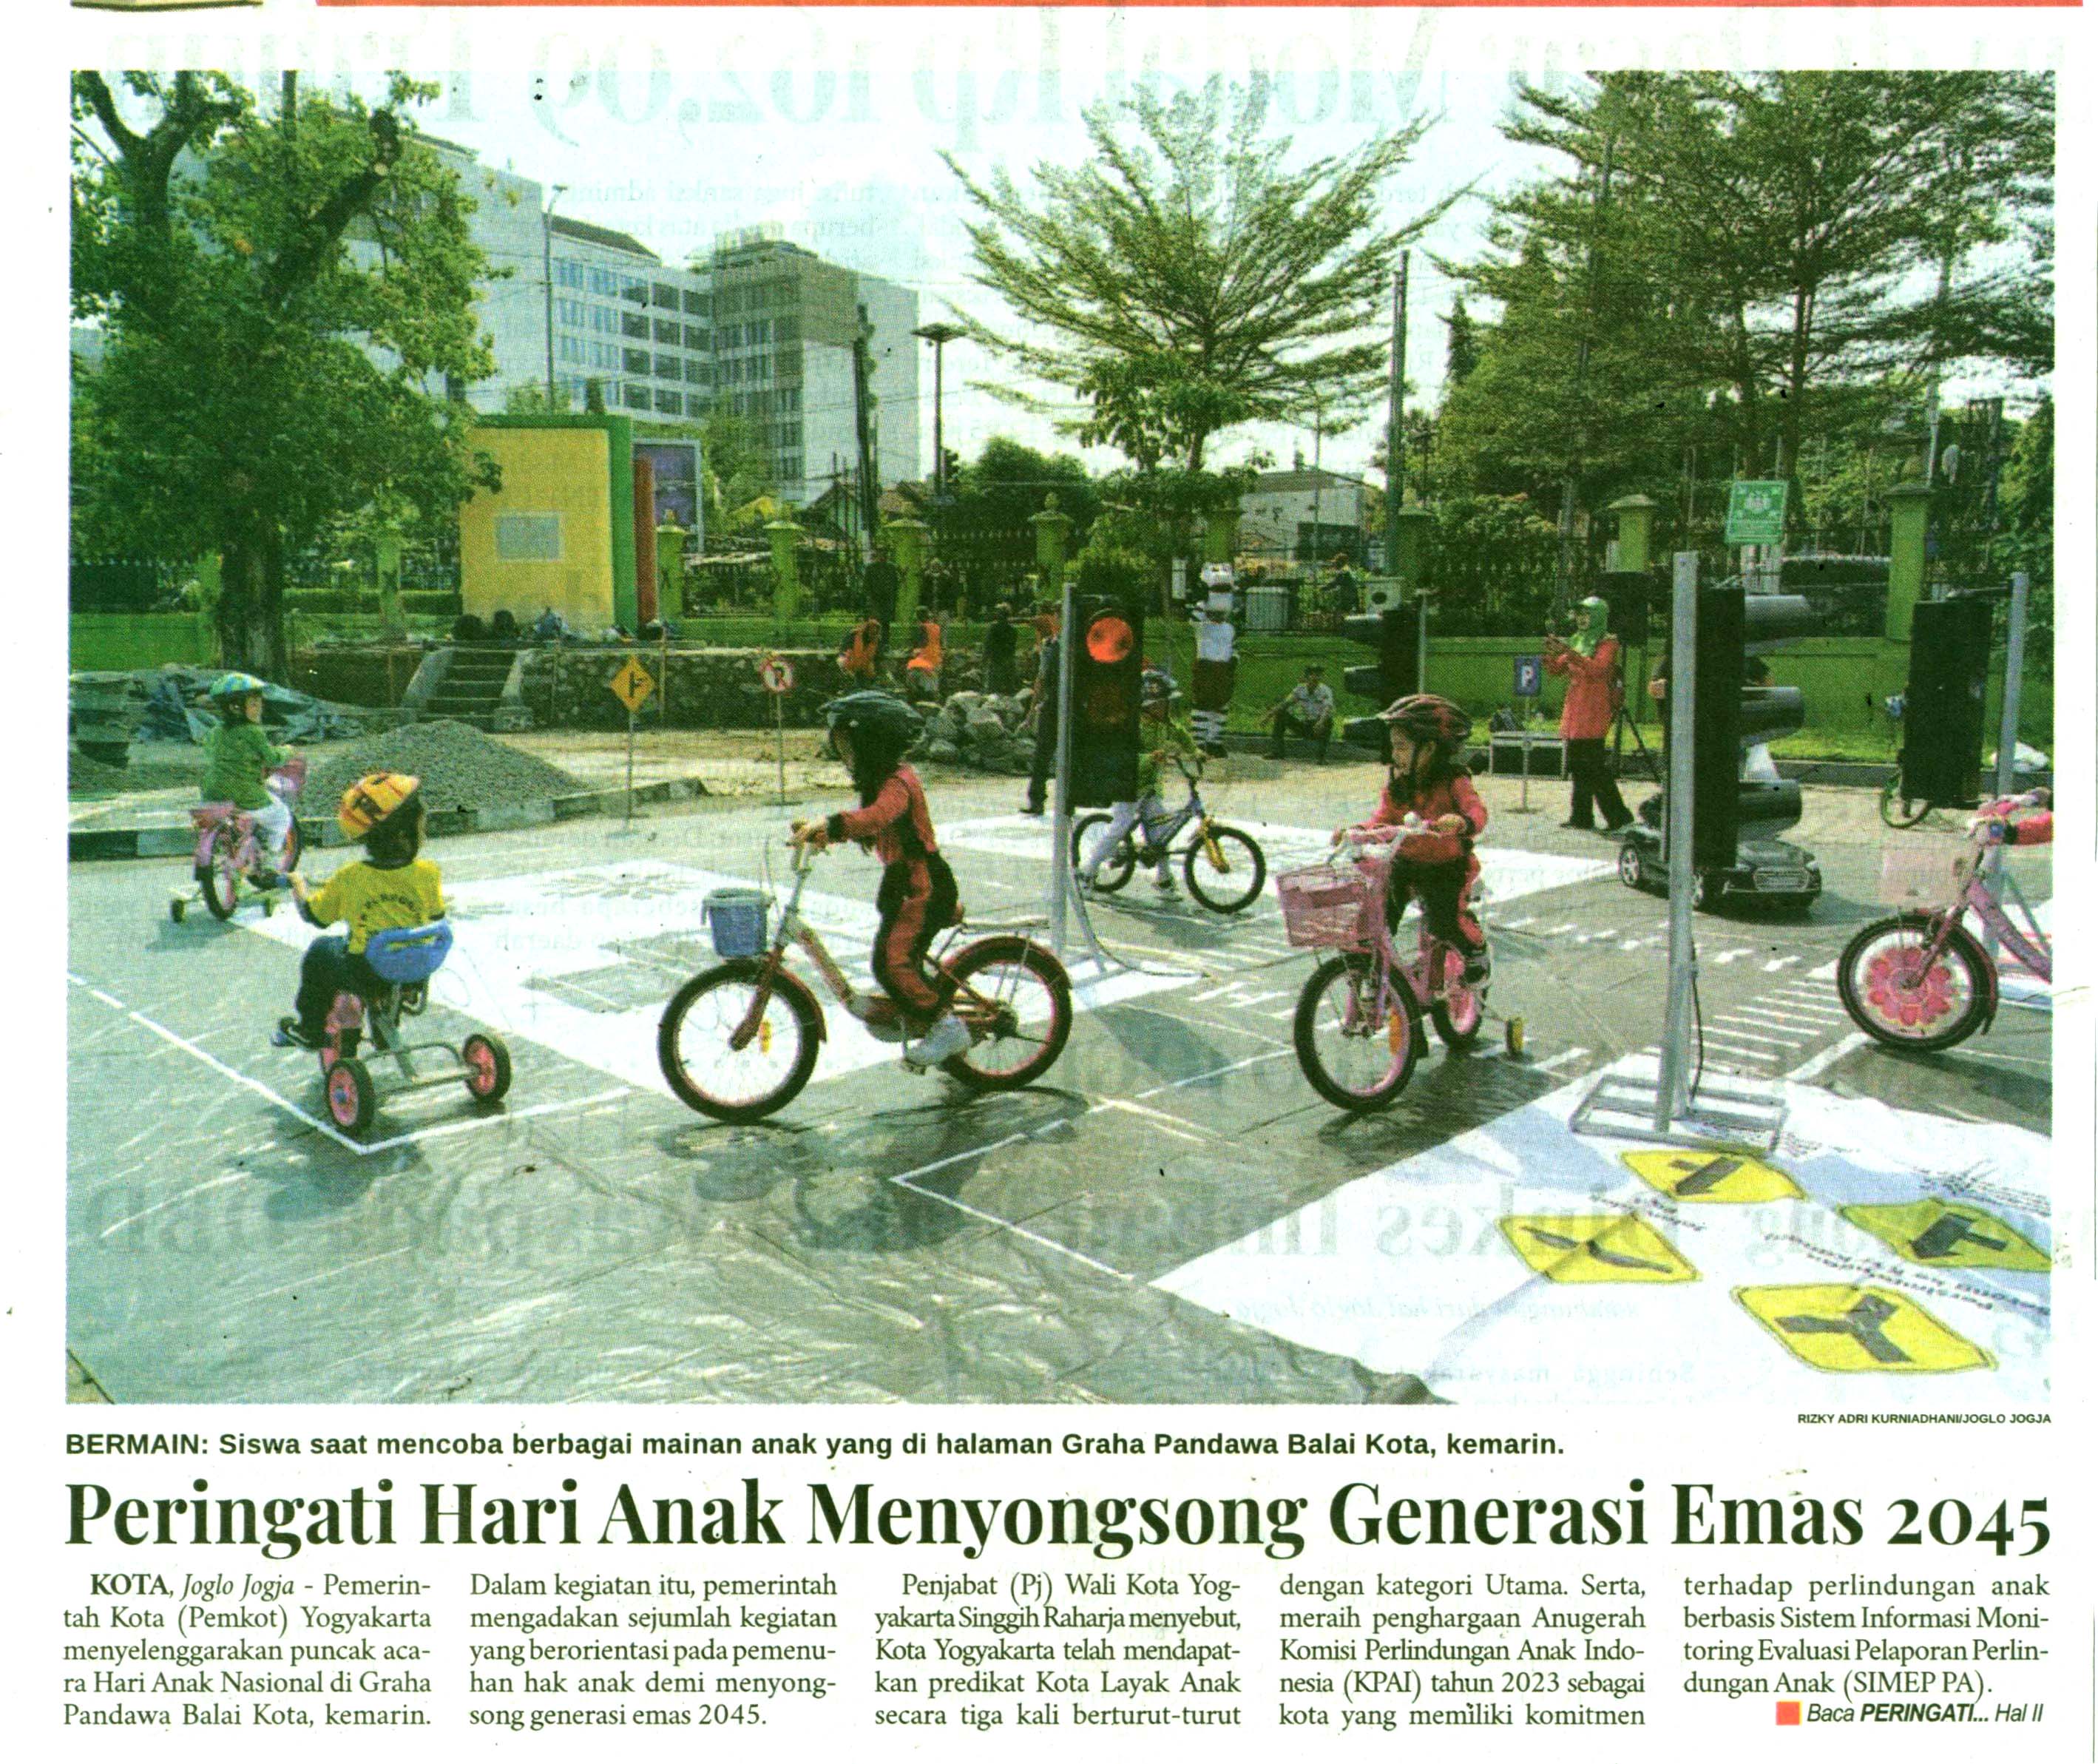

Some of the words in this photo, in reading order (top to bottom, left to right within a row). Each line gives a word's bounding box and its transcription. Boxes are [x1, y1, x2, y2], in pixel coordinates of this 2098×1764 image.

[1520, 665, 1534, 687] P
[1798, 1413, 1835, 1424] RIZKY
[1838, 1413, 1868, 1424] ADRI
[1871, 1413, 2006, 1424] KURNIADHANI/JOGLO
[2009, 1413, 2051, 1424] JOGJA
[66, 1433, 208, 1455] BERMAIN:
[219, 1433, 301, 1455] Siswa
[310, 1435, 368, 1455] saat
[377, 1433, 504, 1455] mencoba
[512, 1432, 632, 1460] berbagai
[643, 1432, 742, 1455] mainan
[751, 1432, 817, 1454] anak
[825, 1437, 892, 1460] yang
[901, 1432, 926, 1455] di
[937, 1432, 1052, 1455] halaman
[1062, 1432, 1146, 1455] Graha
[1154, 1432, 1279, 1455] Pandawa
[1288, 1433, 1356, 1455] Balai
[1366, 1433, 1436, 1459] Kota,
[1447, 1433, 1564, 1455] kemarin.
[64, 1478, 397, 1560] Peringati
[419, 1478, 581, 1545] Hari
[597, 1477, 786, 1545] Anak
[806, 1483, 1308, 1560] Menyongsong
[1329, 1478, 1648, 1546] Generasi
[1671, 1484, 1864, 1546] Emas
[1887, 1496, 2051, 1557] 2045
[90, 1573, 174, 1597] KOTA,
[180, 1573, 234, 1602] Joglo
[240, 1573, 294, 1602] Jogja
[324, 1573, 430, 1595] Pemerin-
[471, 1572, 547, 1595] Dalam
[555, 1572, 652, 1602] kegiatan
[659, 1574, 695, 1598] itu,
[703, 1572, 838, 1602] pemerintah
[902, 1572, 998, 1601] Penjabat
[1010, 1572, 1053, 1606] (Pj)
[1065, 1572, 1116, 1595] Wali
[1126, 1572, 1180, 1595] Kota
[1188, 1573, 1240, 1602] Yog-
[1279, 1572, 1364, 1602] dengan
[1376, 1572, 1472, 1602] kategori
[1486, 1573, 1568, 1595] Utama.
[1581, 1573, 1645, 1598] Serta,
[1684, 1573, 1793, 1602] terhadap
[1809, 1573, 1975, 1602] perlindungan
[1992, 1573, 2050, 1596] anak
[63, 1605, 100, 1628] tah
[110, 1606, 165, 1628] Kota
[177, 1604, 288, 1638] (Pemkot)
[300, 1605, 431, 1635] Yogyakarta
[470, 1605, 619, 1635] mengadakan
[628, 1605, 731, 1634] sejumlah
[740, 1605, 837, 1635] kegiatan
[875, 1605, 955, 1634] yakarta
[958, 1605, 1040, 1635] Singgih
[1043, 1606, 1126, 1635] Raharja
[1128, 1605, 1241, 1635] menyebut,
[1280, 1605, 1361, 1628] meraih
[1373, 1605, 1521, 1635] penghargaan
[1532, 1605, 1646, 1635] Anugerah
[1683, 1605, 1776, 1629] berbasis
[1780, 1606, 1856, 1628] Sistem
[1861, 1605, 1971, 1629] Informasi
[1976, 1606, 2049, 1629] Moni-
[64, 1638, 283, 1667] menyelenggarakan
[290, 1638, 376, 1667] puncak
[383, 1645, 430, 1660] aca-
[470, 1645, 526, 1667] yang
[529, 1638, 669, 1660] berorientasi
[673, 1638, 728, 1667] pada
[732, 1645, 836, 1667] pemenu-
[876, 1638, 927, 1660] Kota
[933, 1638, 1055, 1667] Yogyakarta
[1063, 1638, 1116, 1660] telah
[1123, 1638, 1240, 1667] mendapat-
[1280, 1638, 1357, 1660] Komisi
[1364, 1638, 1511, 1667] Perlindungan
[1517, 1638, 1577, 1660] Anak
[1585, 1638, 1645, 1660] Indo-
[1684, 1640, 1754, 1667] toring
[1758, 1638, 1850, 1660] Evaluasi
[1855, 1638, 1968, 1667] Pelaporan
[1972, 1638, 2048, 1660] Perlin-
[64, 1677, 87, 1693] ra
[94, 1671, 146, 1693] Hari
[151, 1670, 214, 1693] Anak
[220, 1670, 323, 1693] Nasional
[330, 1670, 352, 1693] di
[359, 1670, 431, 1693] Graha
[470, 1670, 514, 1693] han
[524, 1670, 568, 1693] hak
[578, 1670, 635, 1693] anak
[645, 1670, 705, 1693] demi
[716, 1677, 836, 1700] menyong-
[875, 1670, 918, 1693] kan
[928, 1670, 1025, 1699] predikat
[1036, 1670, 1089, 1693] Kota
[1100, 1670, 1170, 1699] Layak
[1180, 1670, 1242, 1693] Anak
[1280, 1672, 1334, 1693] nesia
[1344, 1669, 1421, 1704] (KPAI)
[1431, 1670, 1494, 1693] tahun
[1501, 1672, 1560, 1693] 2023
[1567, 1670, 1645, 1700] sebagai
[1683, 1670, 1769, 1700] dungan
[1773, 1671, 1835, 1693] Anak
[1844, 1670, 1936, 1703] (SIMEP
[1942, 1671, 1992, 1703] PA).
[64, 1703, 171, 1726] Pandawa
[183, 1703, 241, 1726] Balai
[253, 1703, 314, 1728] Kota,
[325, 1703, 430, 1725] kemarin.
[470, 1710, 525, 1731] song
[529, 1704, 626, 1731] generasi
[632, 1710, 691, 1725] emas
[698, 1703, 766, 1725] 2045.
[875, 1709, 947, 1725] secara
[961, 1704, 1004, 1731] tiga
[1017, 1702, 1060, 1725] kali
[1072, 1702, 1241, 1726] berturut-turut
[1279, 1703, 1329, 1725] kota
[1341, 1710, 1397, 1731] yang
[1409, 1702, 1513, 1725] memiliki
[1526, 1703, 1645, 1726] komitmen
[1807, 1703, 1855, 1723] Baca
[1860, 1703, 1989, 1723] PERINGATI...
[1994, 1703, 2028, 1723] Hal
